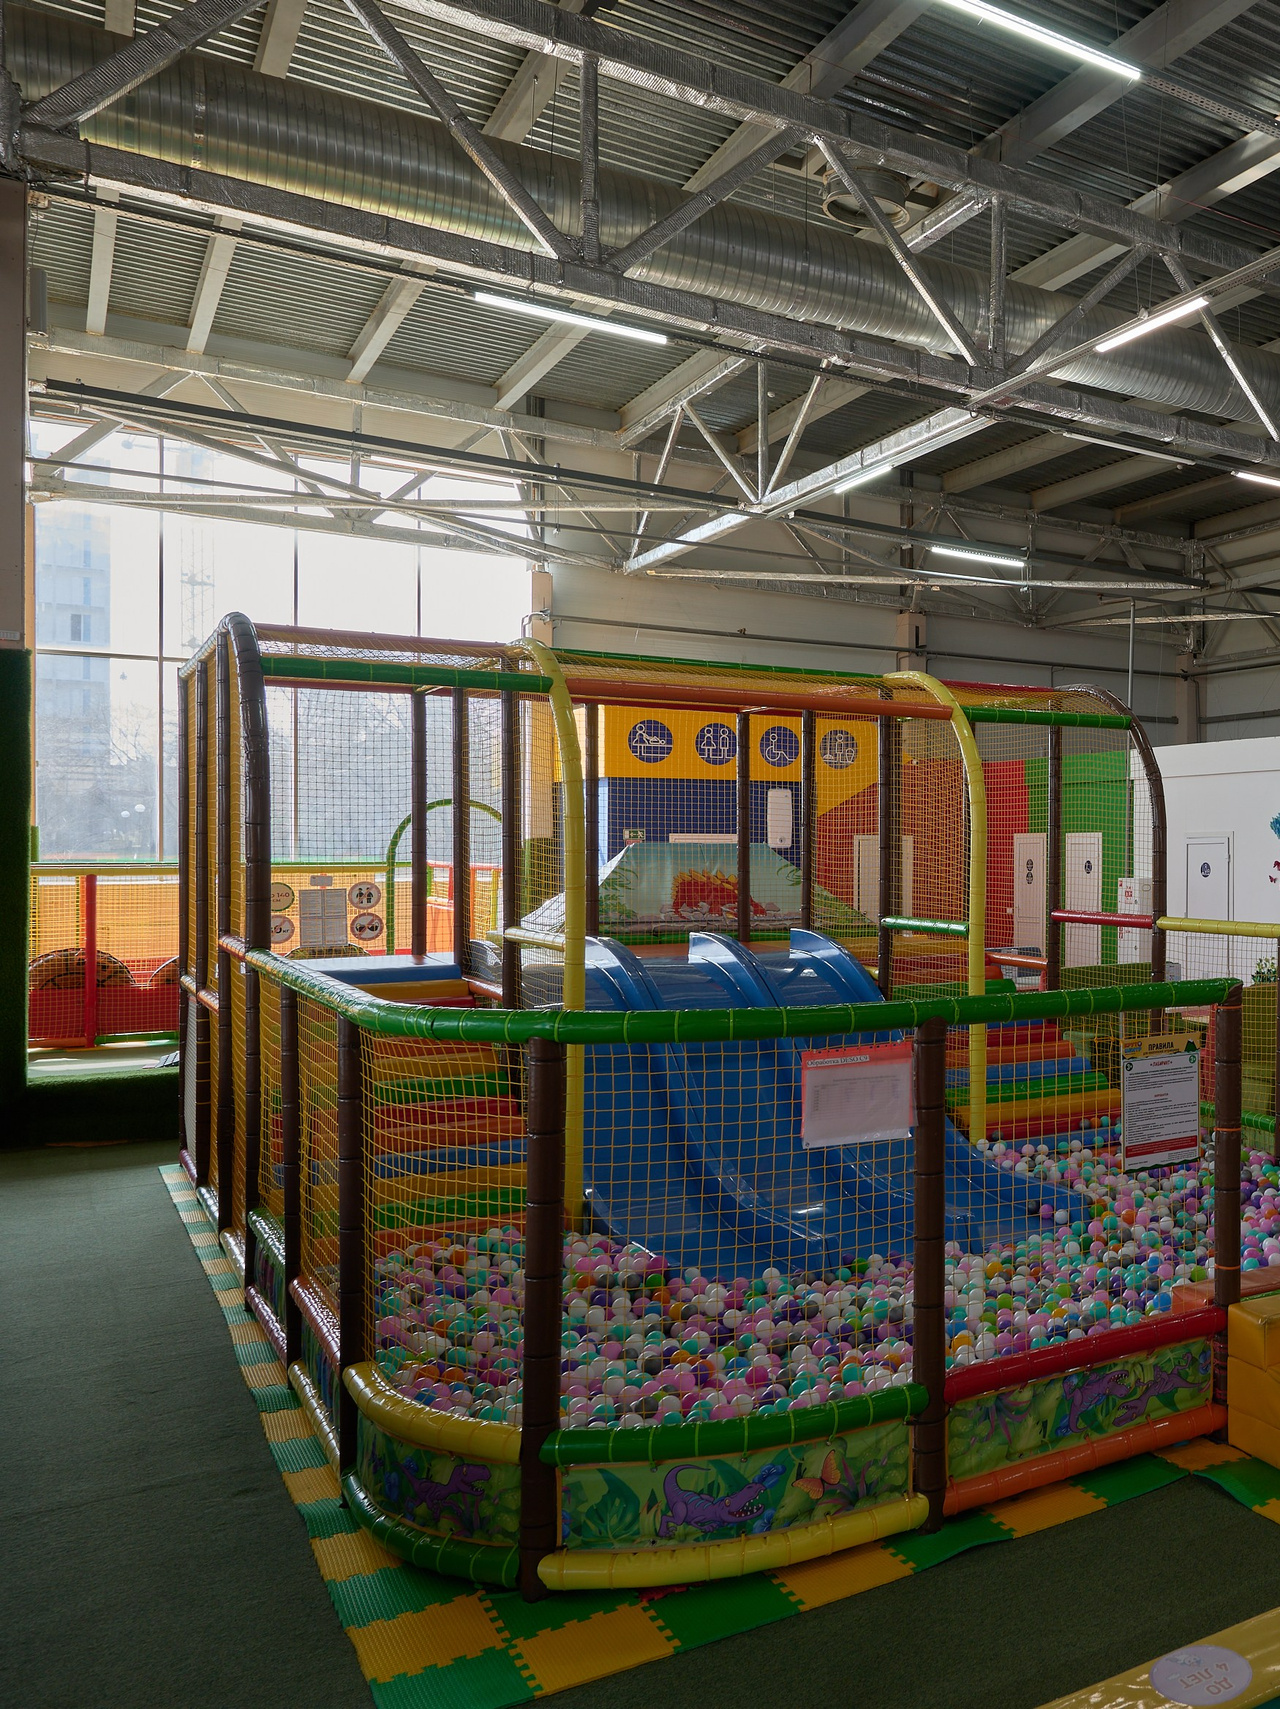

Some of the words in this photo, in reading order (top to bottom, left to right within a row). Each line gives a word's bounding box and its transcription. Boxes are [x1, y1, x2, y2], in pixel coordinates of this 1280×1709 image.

[1148, 1041, 1174, 1051] ПРАВИЛА
[1215, 1663, 1229, 1672] 4
[1180, 1668, 1214, 1689] ЛЕТ
[1206, 1676, 1234, 1695] ДО
